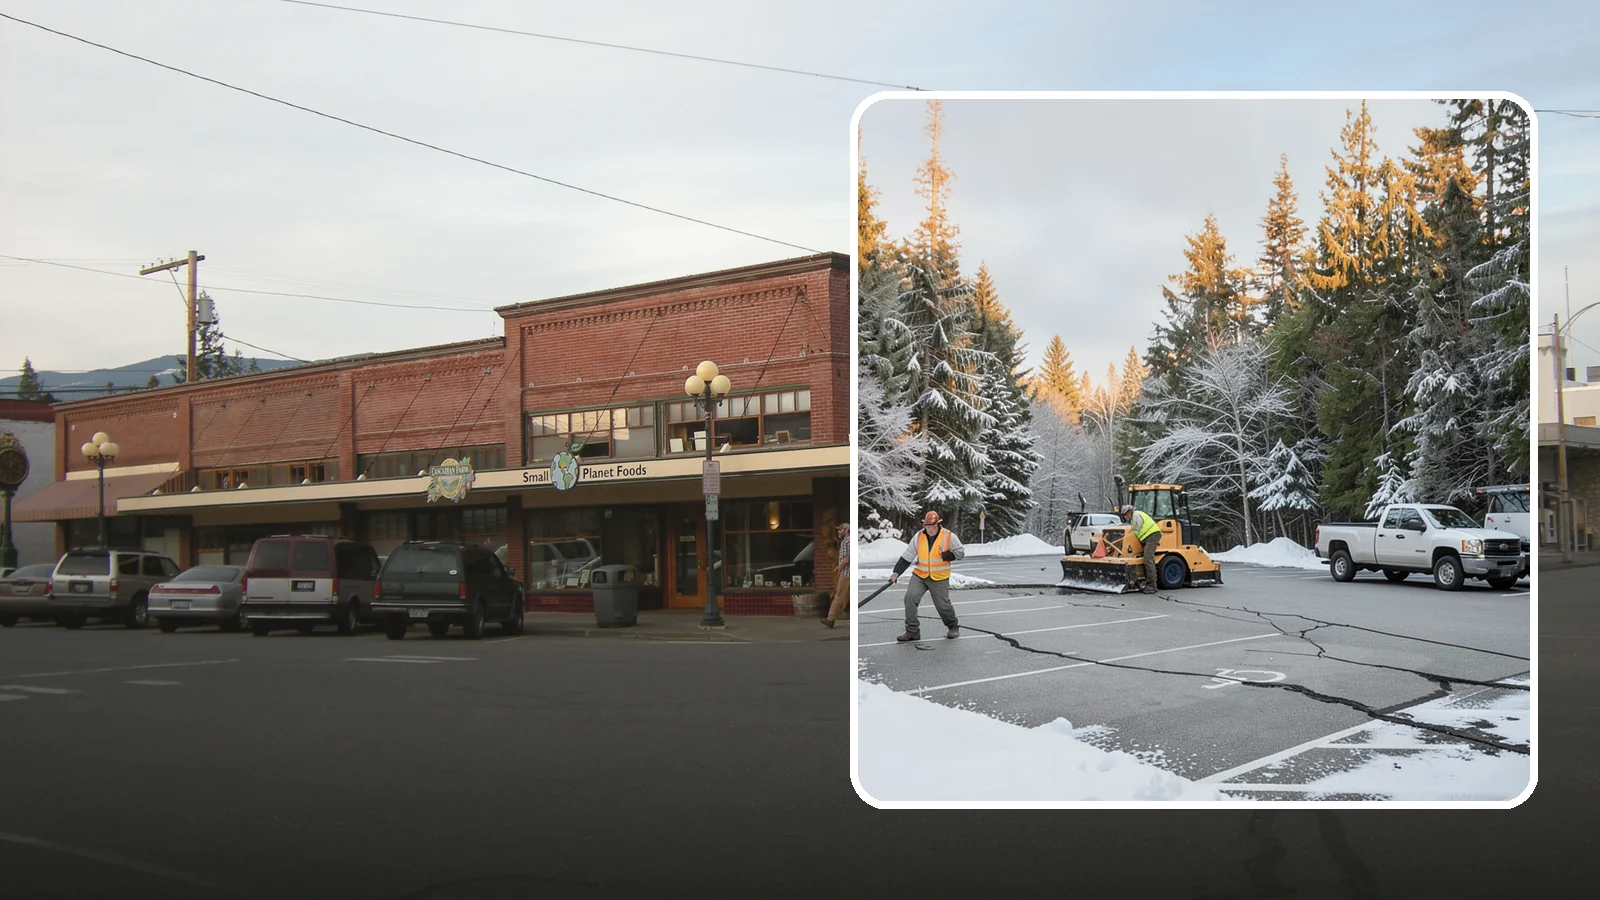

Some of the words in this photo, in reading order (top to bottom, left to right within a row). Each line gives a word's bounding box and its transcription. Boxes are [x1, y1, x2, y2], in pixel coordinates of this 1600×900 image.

[523, 471, 549, 482] Small
[583, 468, 613, 479] Planet
[617, 464, 647, 477] Foods
